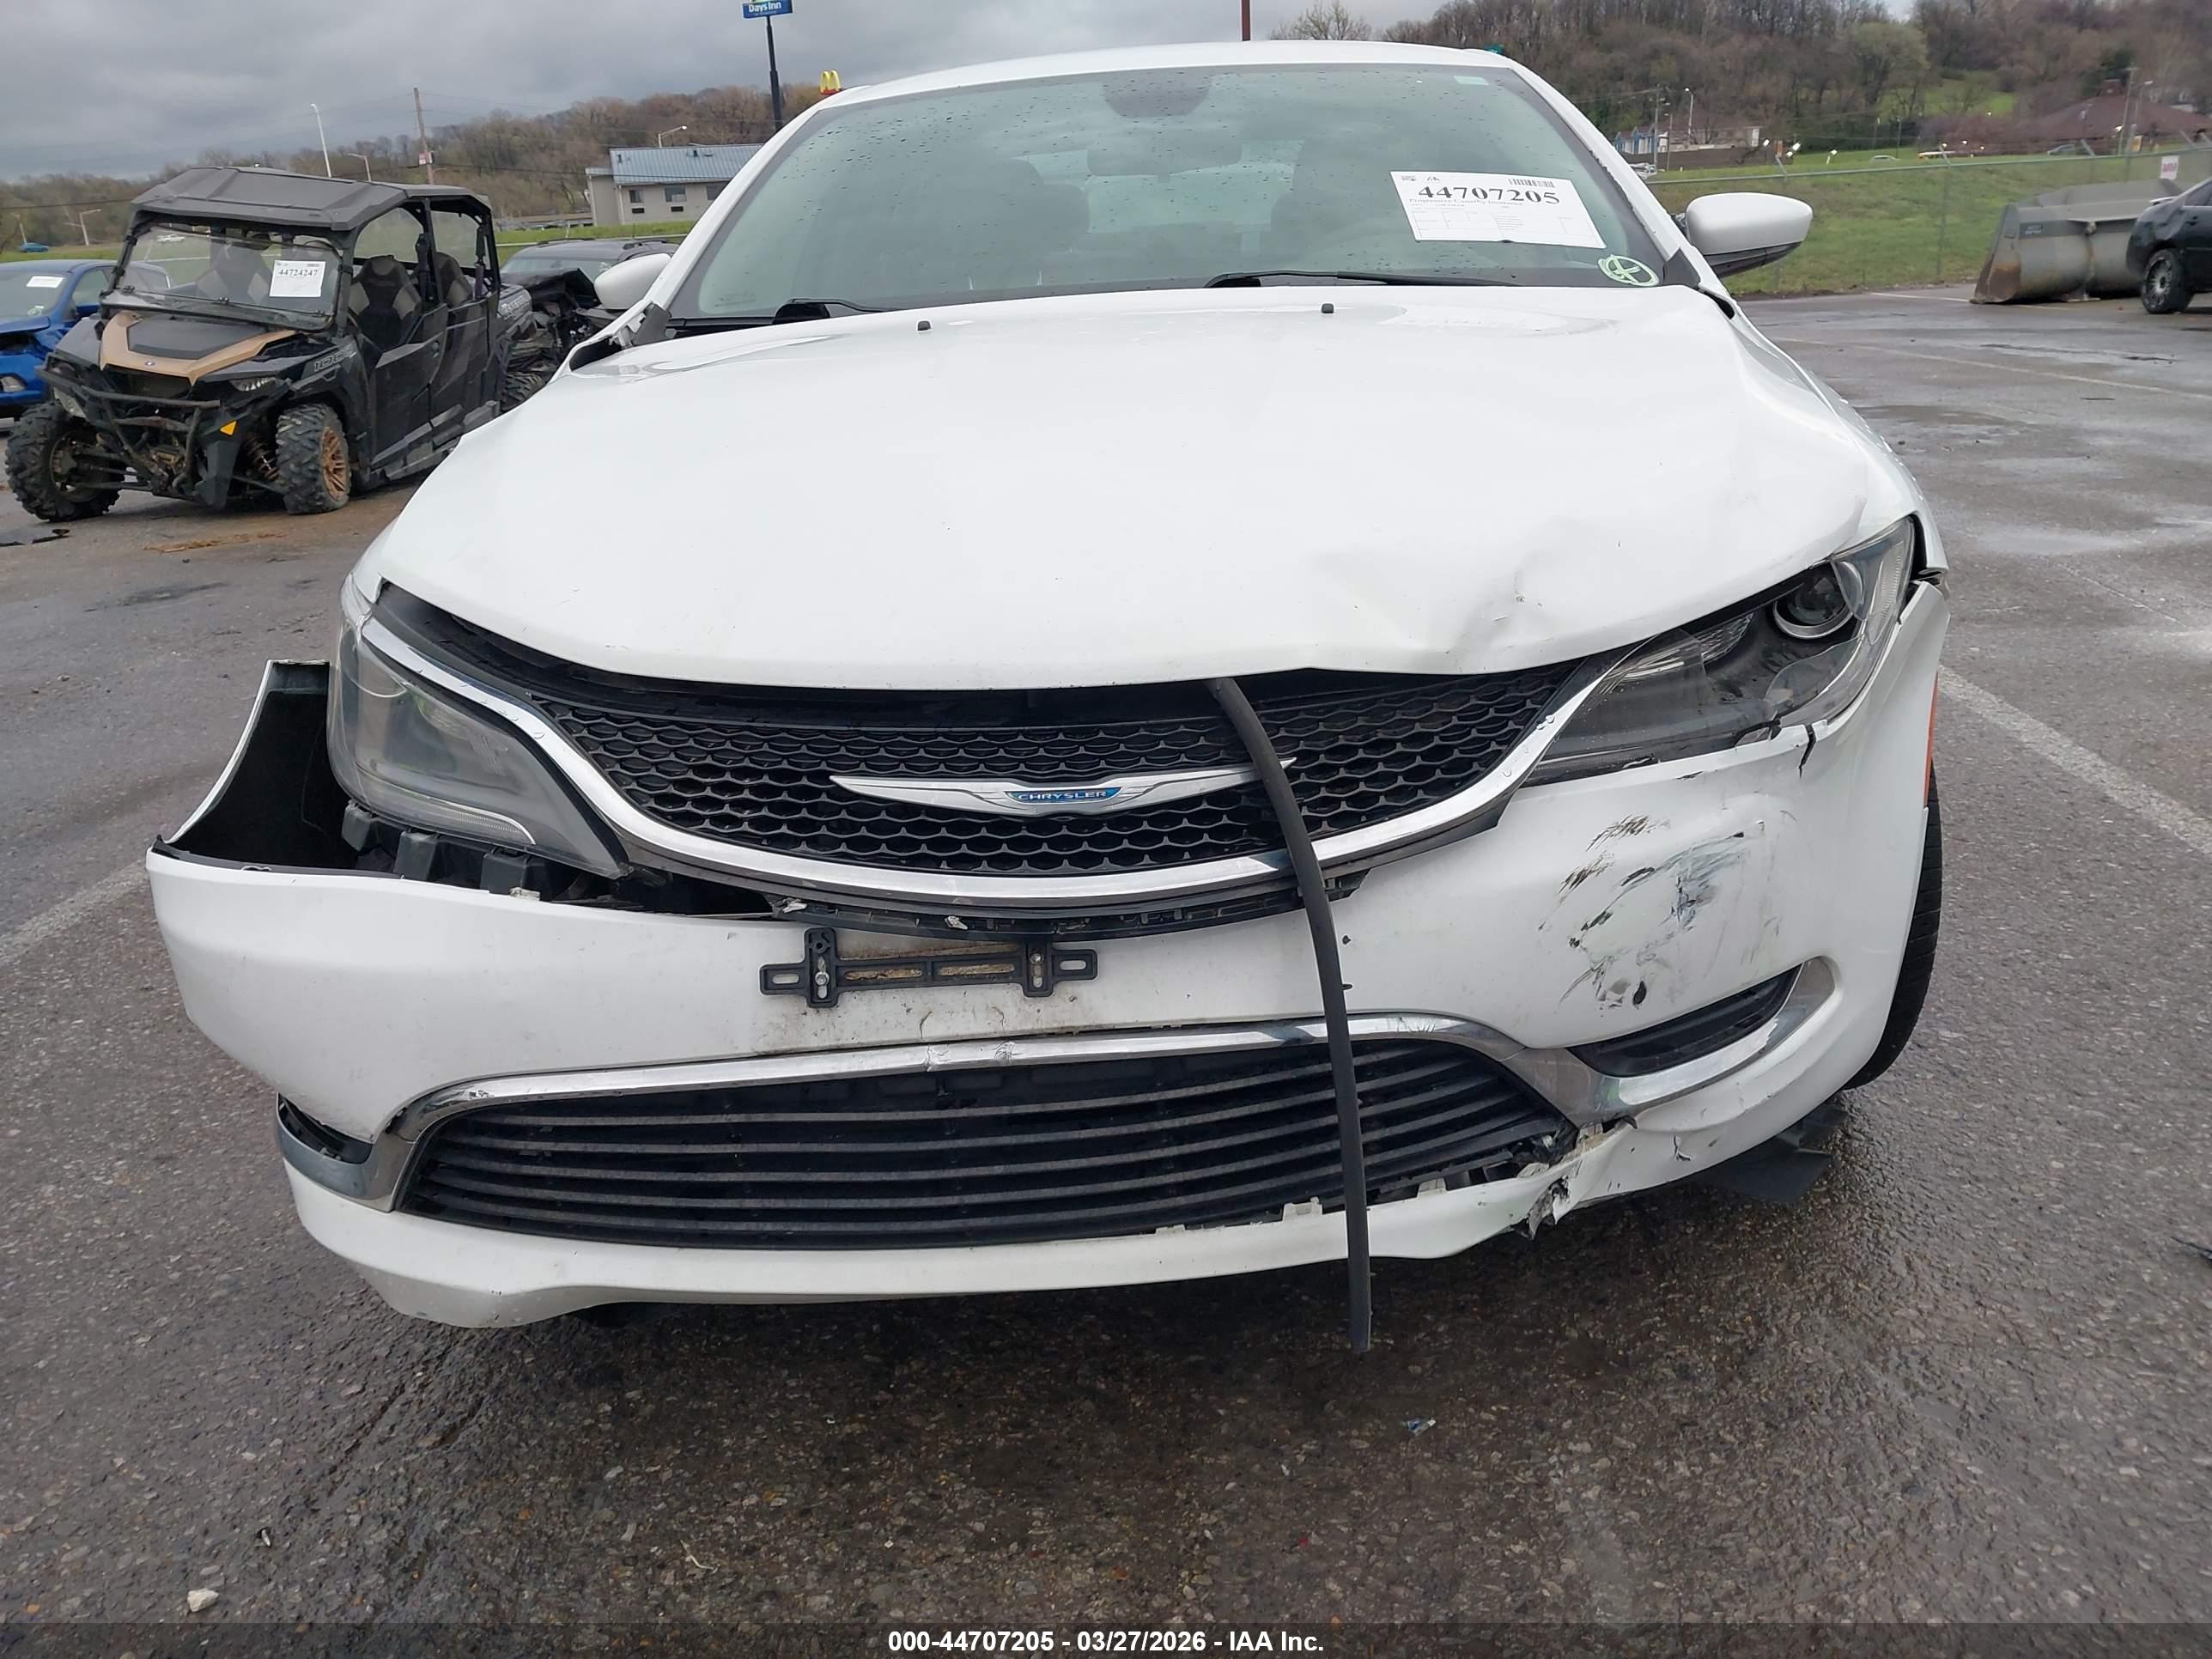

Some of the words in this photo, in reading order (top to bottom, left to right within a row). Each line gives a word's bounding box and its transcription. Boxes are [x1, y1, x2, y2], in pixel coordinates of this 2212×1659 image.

[748, 3, 768, 14] Days
[768, 1, 782, 10] Inn
[1418, 185, 1560, 205] 44707205
[278, 268, 319, 276] 44724247
[1018, 791, 1107, 800] CHRYSLER
